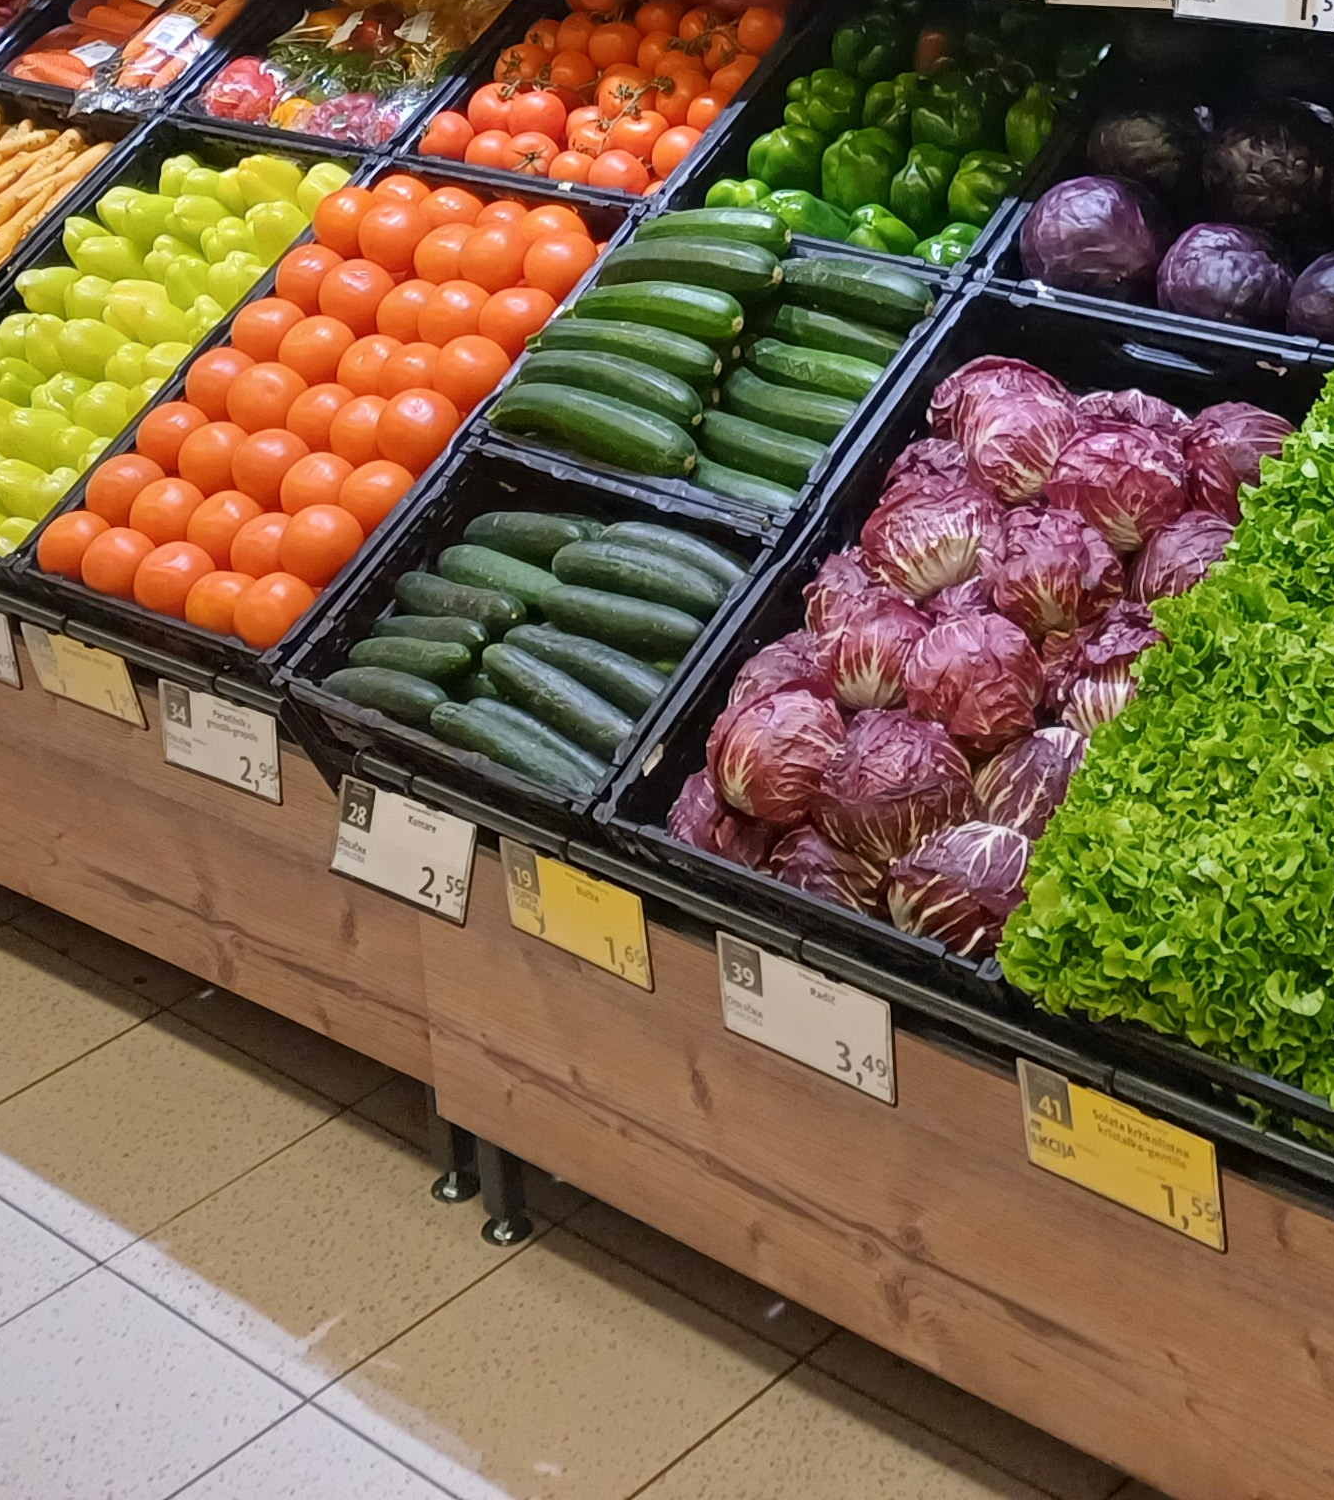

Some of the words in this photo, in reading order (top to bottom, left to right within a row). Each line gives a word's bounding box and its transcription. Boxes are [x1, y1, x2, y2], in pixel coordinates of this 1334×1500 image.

[170, 702, 186, 723] 34
[347, 802, 367, 827] 28
[418, 866, 465, 908] 2,59
[513, 866, 532, 889] 19
[730, 961, 755, 988] 39
[835, 1040, 887, 1086] 3,49
[1038, 1095, 1063, 1122] 41
[1092, 1108, 1126, 1133] Solata
